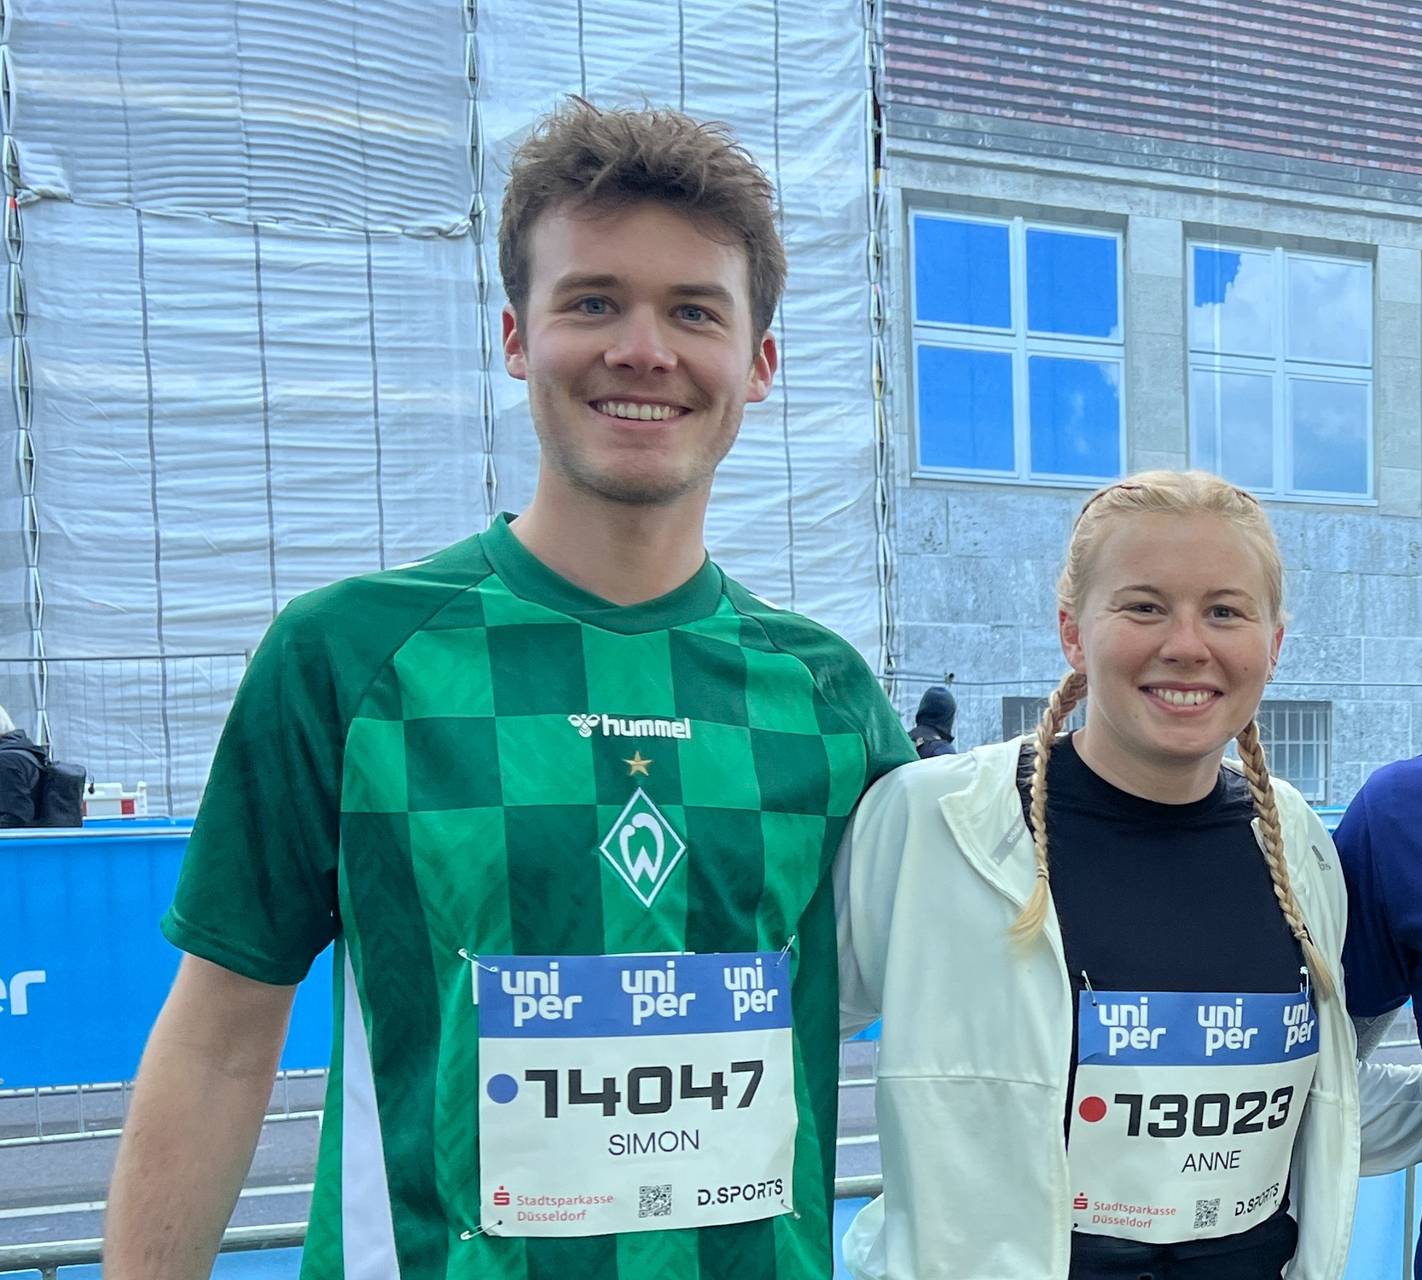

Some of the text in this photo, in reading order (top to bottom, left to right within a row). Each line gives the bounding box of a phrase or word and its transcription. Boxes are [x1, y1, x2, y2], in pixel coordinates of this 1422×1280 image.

[602, 714, 691, 739] hummel
[501, 962, 559, 995] uni
[621, 961, 675, 993] uni
[724, 957, 762, 990] uni
[513, 995, 583, 1027] per
[632, 993, 696, 1026] per
[733, 988, 778, 1022] per
[1098, 996, 1148, 1027] uni
[1198, 998, 1243, 1028] uni
[1282, 1000, 1309, 1025] uni
[1108, 1026, 1167, 1056] per
[1205, 1027, 1258, 1057] per
[1284, 1019, 1315, 1054] per
[525, 1059, 764, 1118] 14047
[1114, 1085, 1294, 1138] 13023
[608, 1129, 700, 1156] SIMON
[1181, 1150, 1242, 1174] ANNE
[517, 1193, 614, 1207] Stadtsparkasse
[697, 1178, 783, 1206] D.SPORTS
[1234, 1182, 1280, 1217] D.SPORTS
[517, 1209, 586, 1223] Düsseldorf
[1092, 1214, 1153, 1229] Düsseldorf
[1093, 1200, 1177, 1216] Stadtsparkasse
